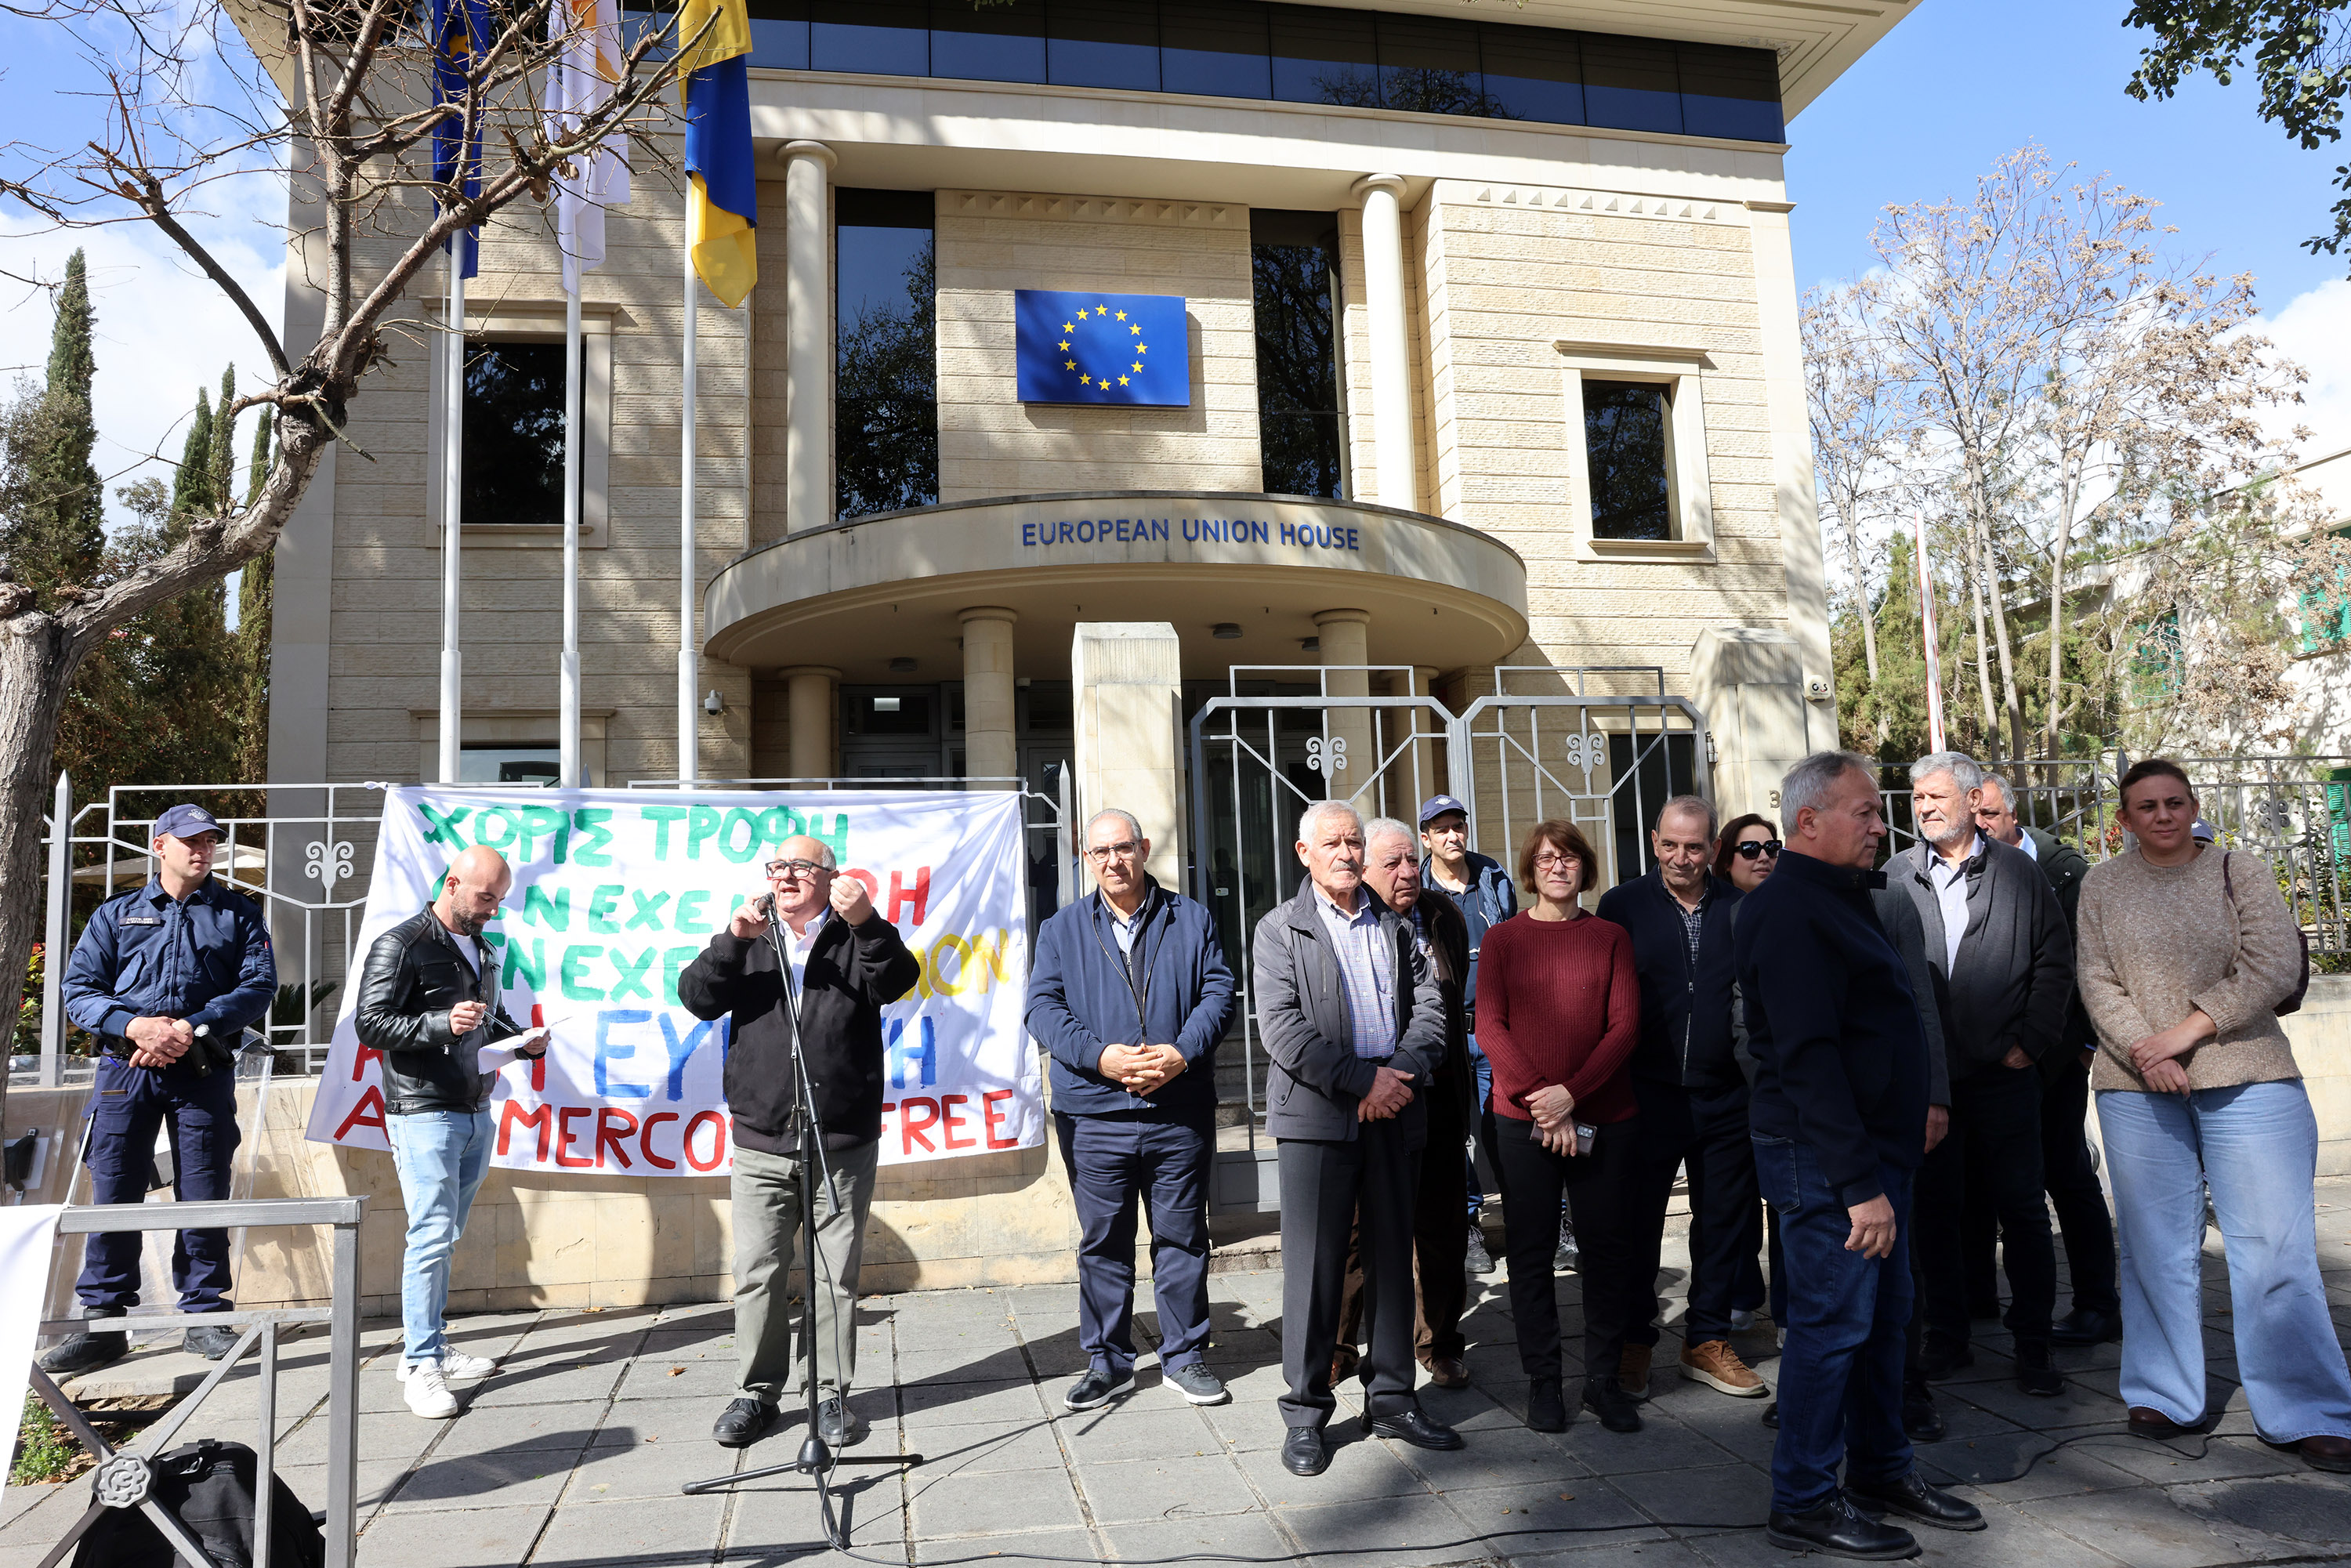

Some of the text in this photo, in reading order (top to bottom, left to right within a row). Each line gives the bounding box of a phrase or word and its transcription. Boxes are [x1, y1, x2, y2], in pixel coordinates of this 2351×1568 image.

[1023, 519, 1360, 550] EUROPEAN UNION HOUSE
[641, 804, 849, 866] ΤΡΟΦΗ
